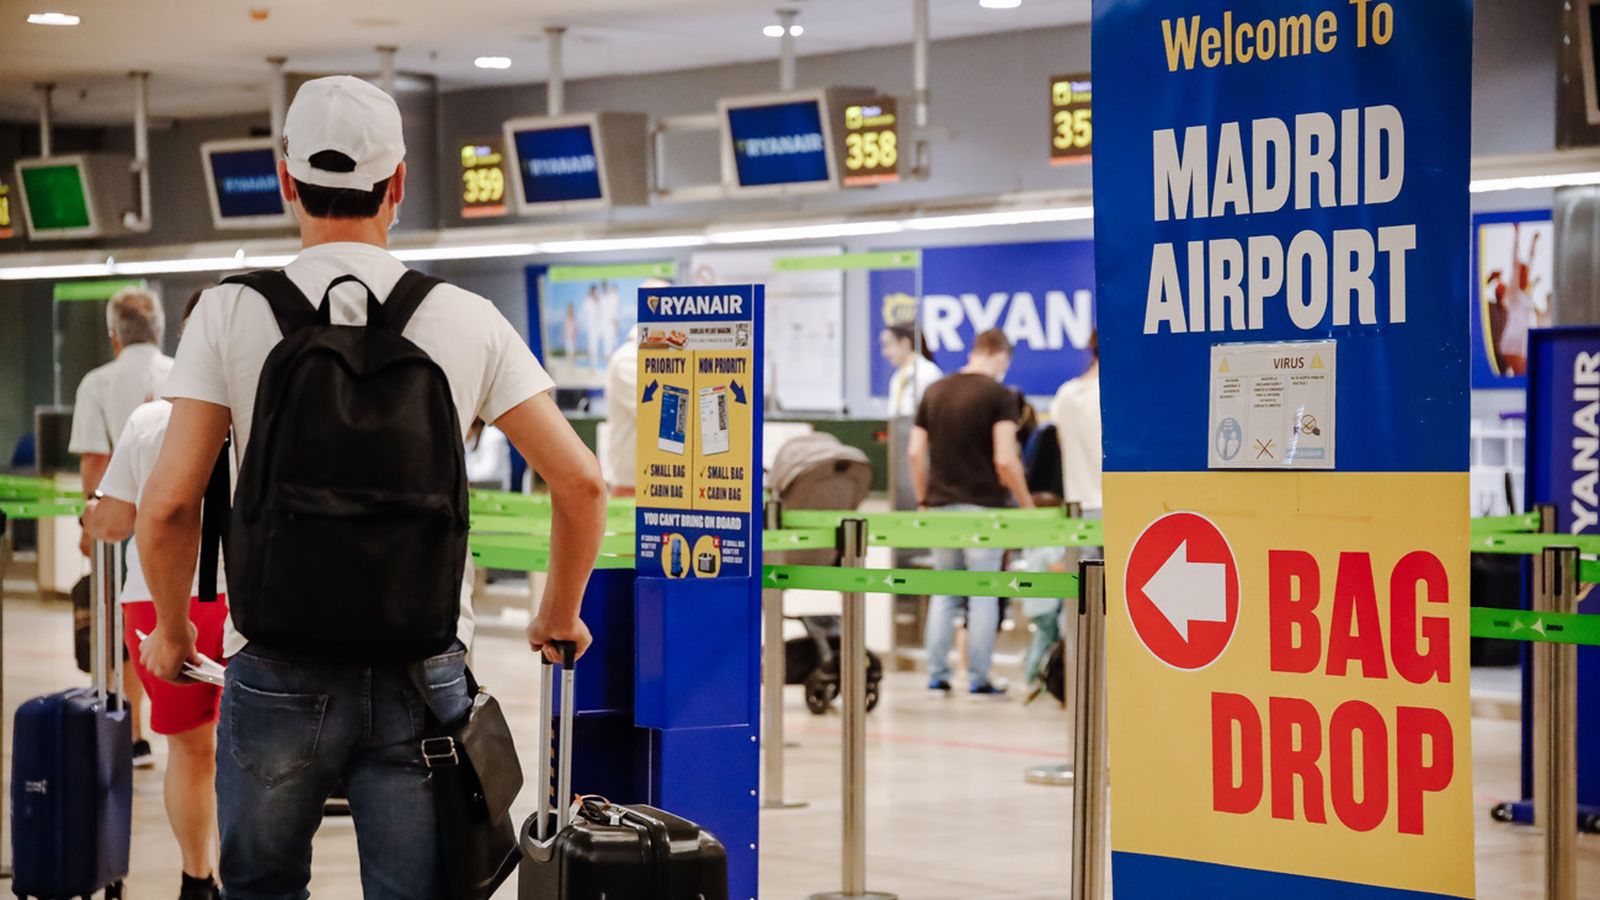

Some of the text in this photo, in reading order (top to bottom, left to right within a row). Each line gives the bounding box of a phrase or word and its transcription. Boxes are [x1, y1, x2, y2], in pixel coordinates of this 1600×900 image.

[1161, 0, 1394, 72] Welcome To
[845, 130, 897, 170] 358
[1152, 104, 1405, 222] MADRID
[463, 167, 504, 203] 359
[1143, 224, 1417, 334] AIRPORT
[660, 294, 743, 316] RYANAIR
[645, 358, 686, 374] PRIORITY
[699, 357, 746, 374] NON PRIORITY
[1273, 356, 1305, 369] VIRUS
[650, 464, 686, 478] SMALL BAG
[707, 466, 744, 480] SMALL BAG
[650, 484, 683, 498] CABIN BAG
[707, 486, 741, 501] CABIN BAG
[644, 512, 659, 526] YOU
[660, 513, 680, 527] CAN'T
[704, 516, 716, 530] ON
[716, 517, 742, 530] BOARD
[1268, 549, 1452, 685] BAG
[1211, 691, 1454, 836] DROP
